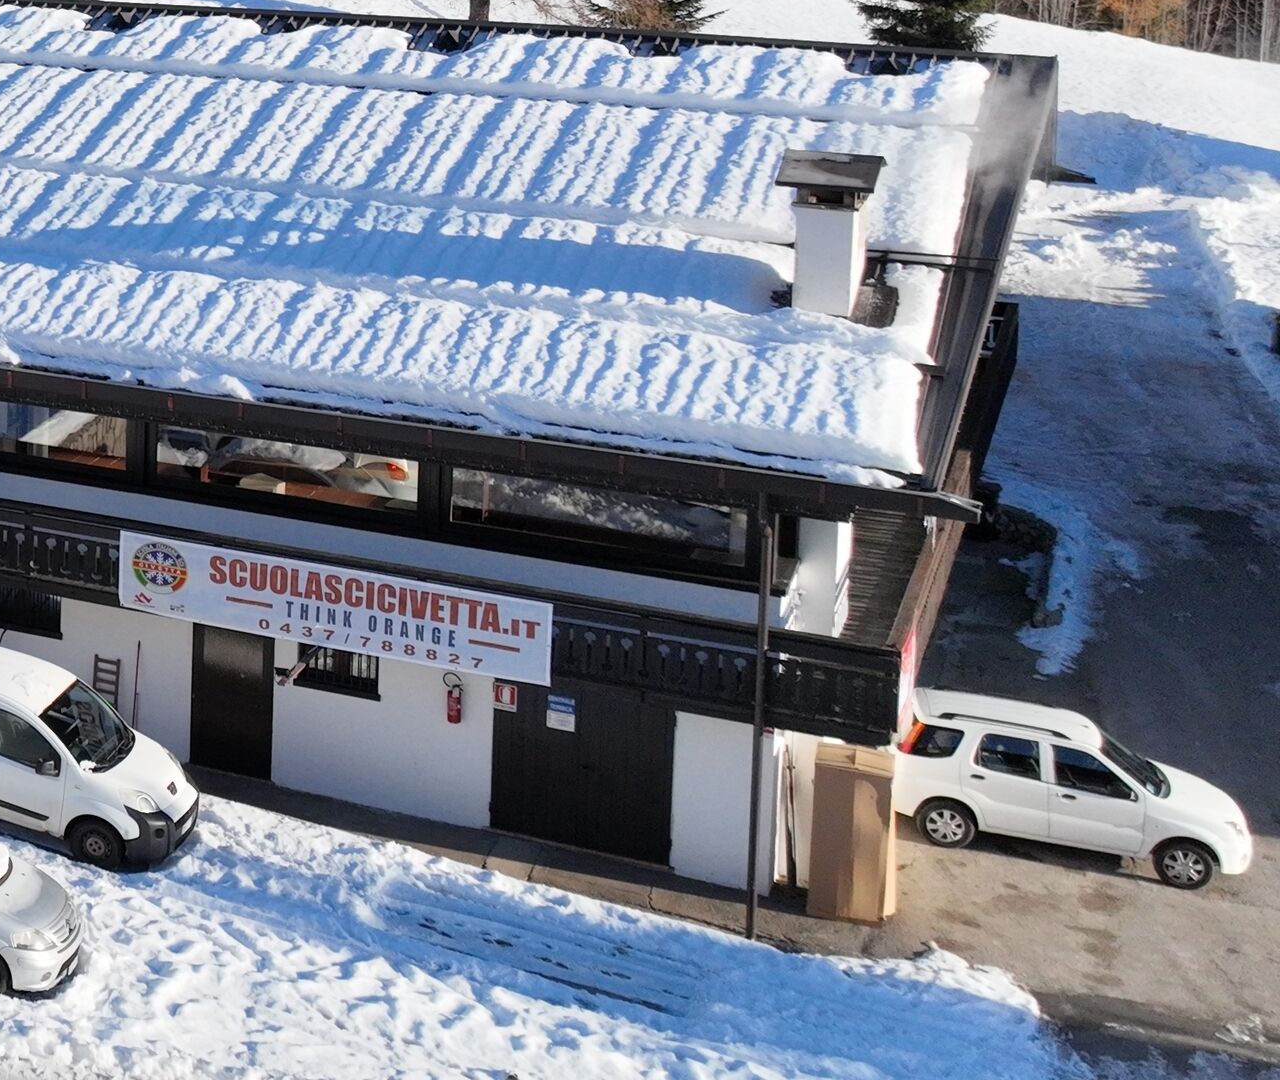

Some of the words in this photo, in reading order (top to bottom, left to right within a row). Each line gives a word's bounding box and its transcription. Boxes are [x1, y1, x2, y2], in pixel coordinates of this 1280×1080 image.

[138, 561, 182, 576] CIVETTA
[208, 555, 541, 639] SCUOLASCICIVETTA.IT
[258, 618, 484, 669] 0437/788827
[285, 600, 353, 629] THINK
[368, 614, 456, 648] ORANGE
